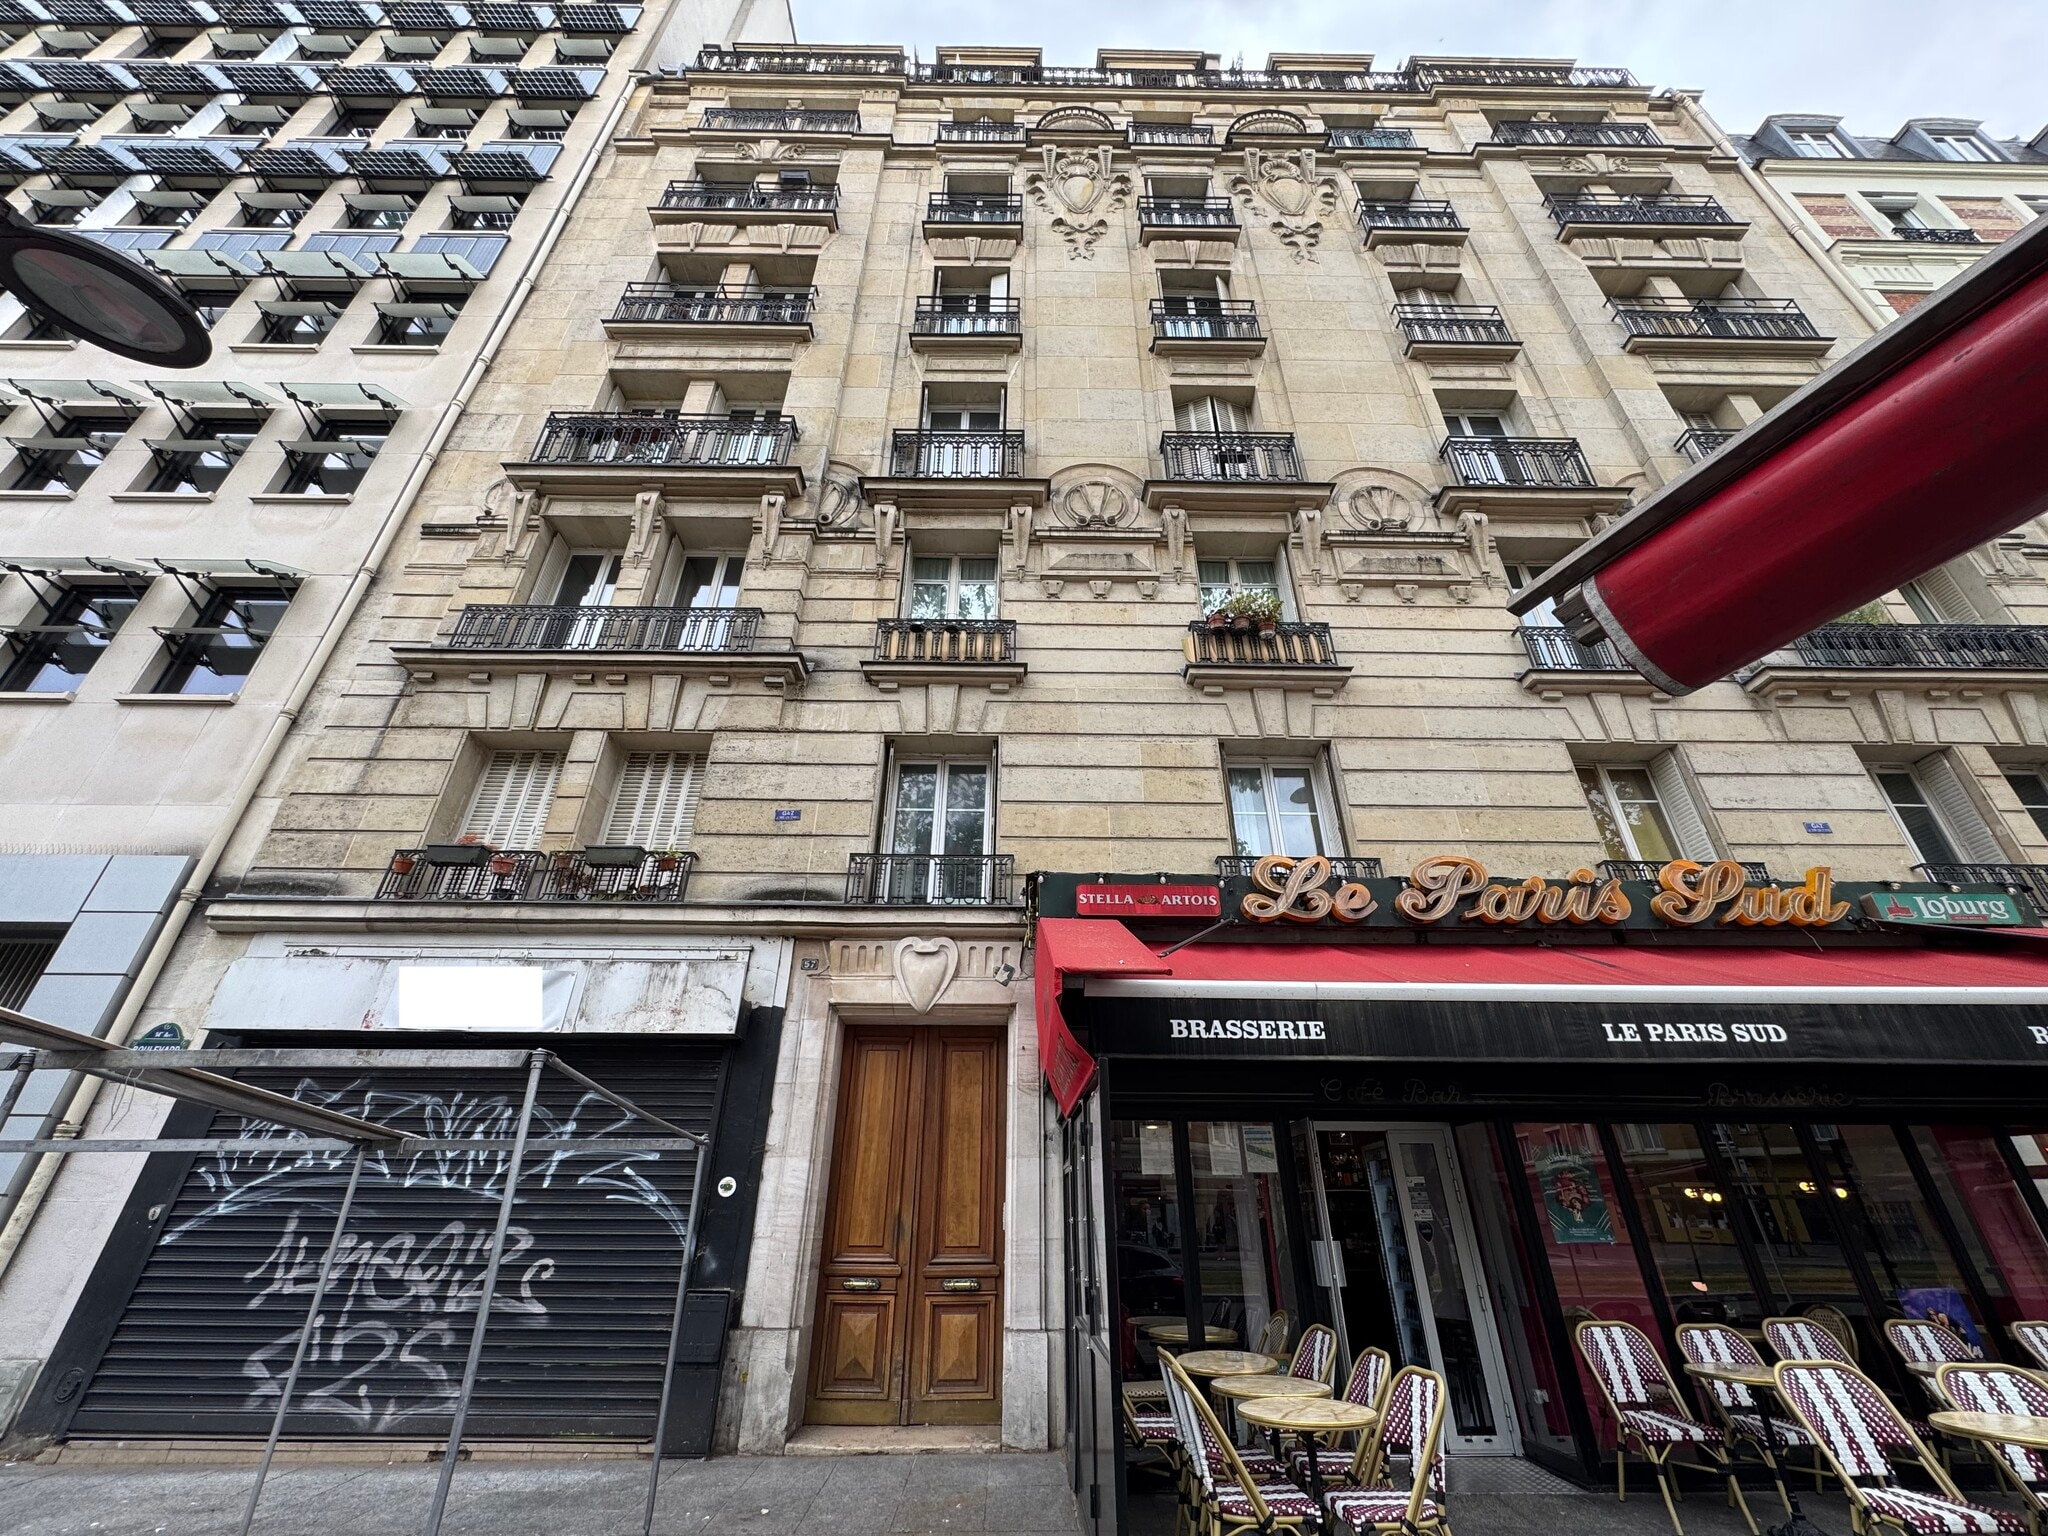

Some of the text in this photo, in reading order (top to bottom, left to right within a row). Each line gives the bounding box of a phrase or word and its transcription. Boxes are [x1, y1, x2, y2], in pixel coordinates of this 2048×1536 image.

[1078, 892, 1218, 906] STELLA ARTOIS
[1240, 855, 1851, 928] Le Paris Sud
[1912, 895, 2010, 920] Loburg
[1169, 1018, 1327, 1041] BRASSERIE
[1601, 1022, 1788, 1043] LE PARIS SUD
